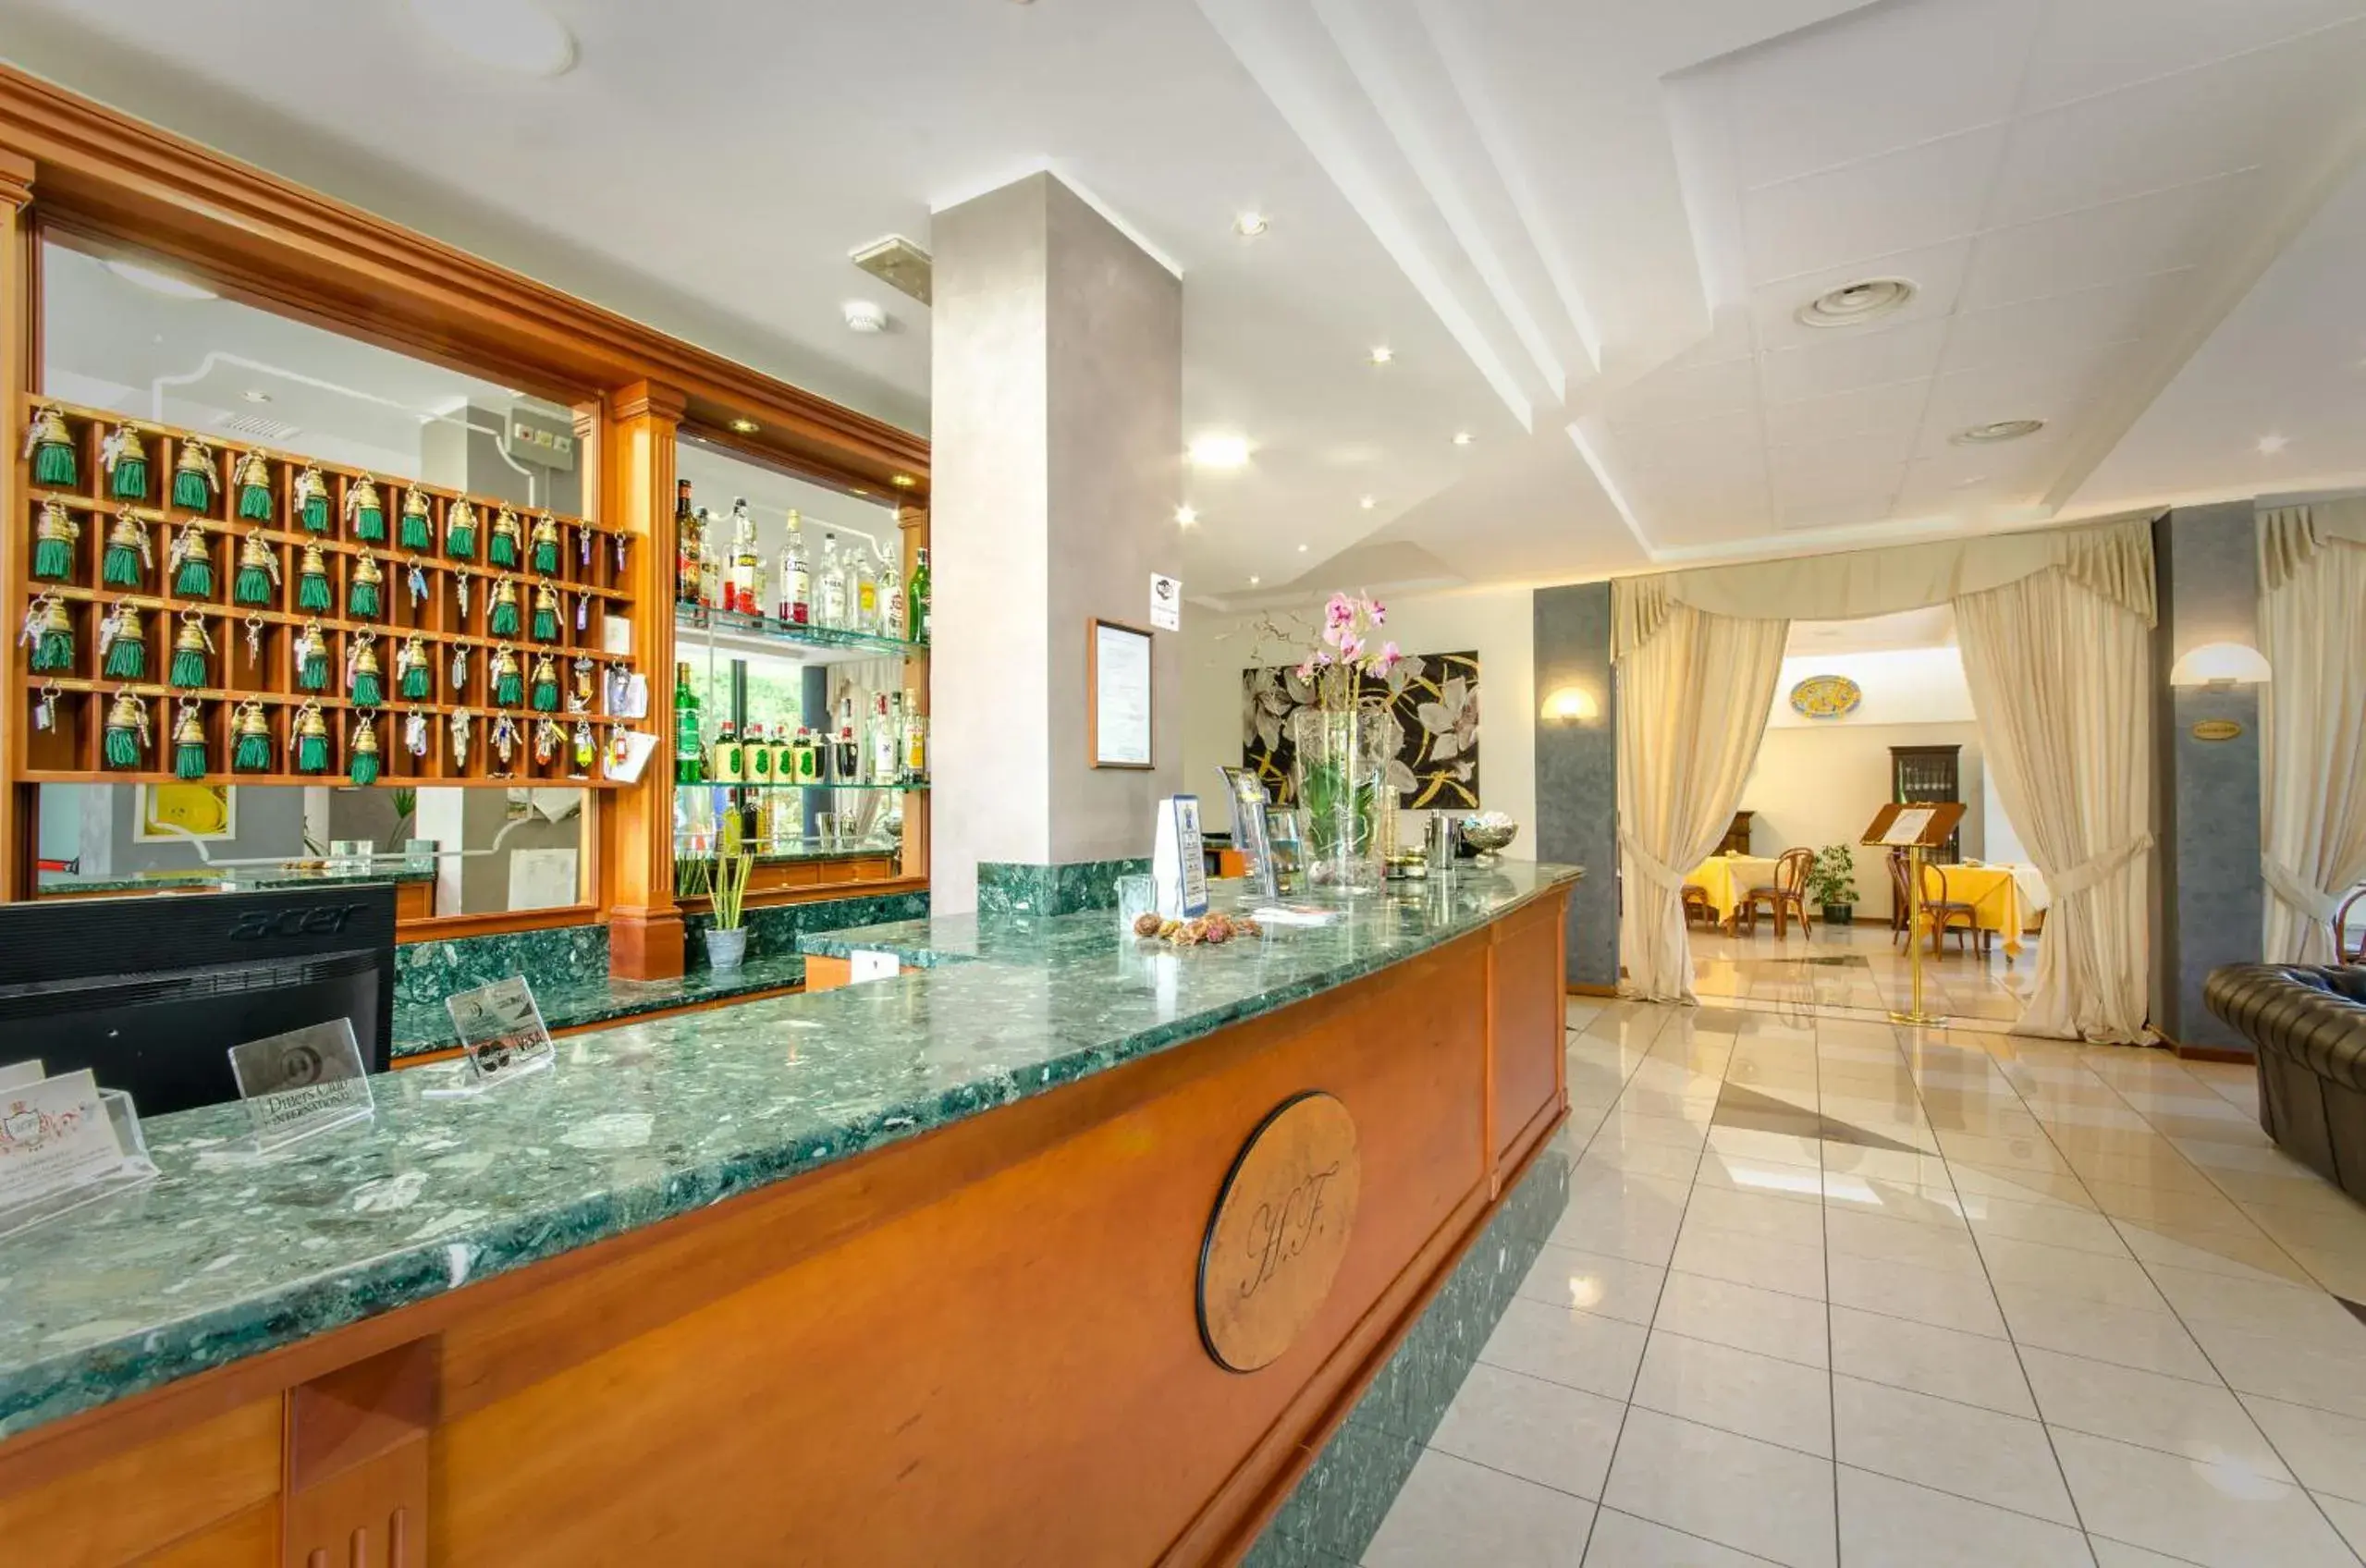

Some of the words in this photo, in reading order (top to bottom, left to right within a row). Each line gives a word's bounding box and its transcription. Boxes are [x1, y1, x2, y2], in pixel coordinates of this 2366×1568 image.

[228, 902, 368, 940] acer
[517, 1031, 543, 1051] VISA
[267, 1091, 315, 1114] Diners
